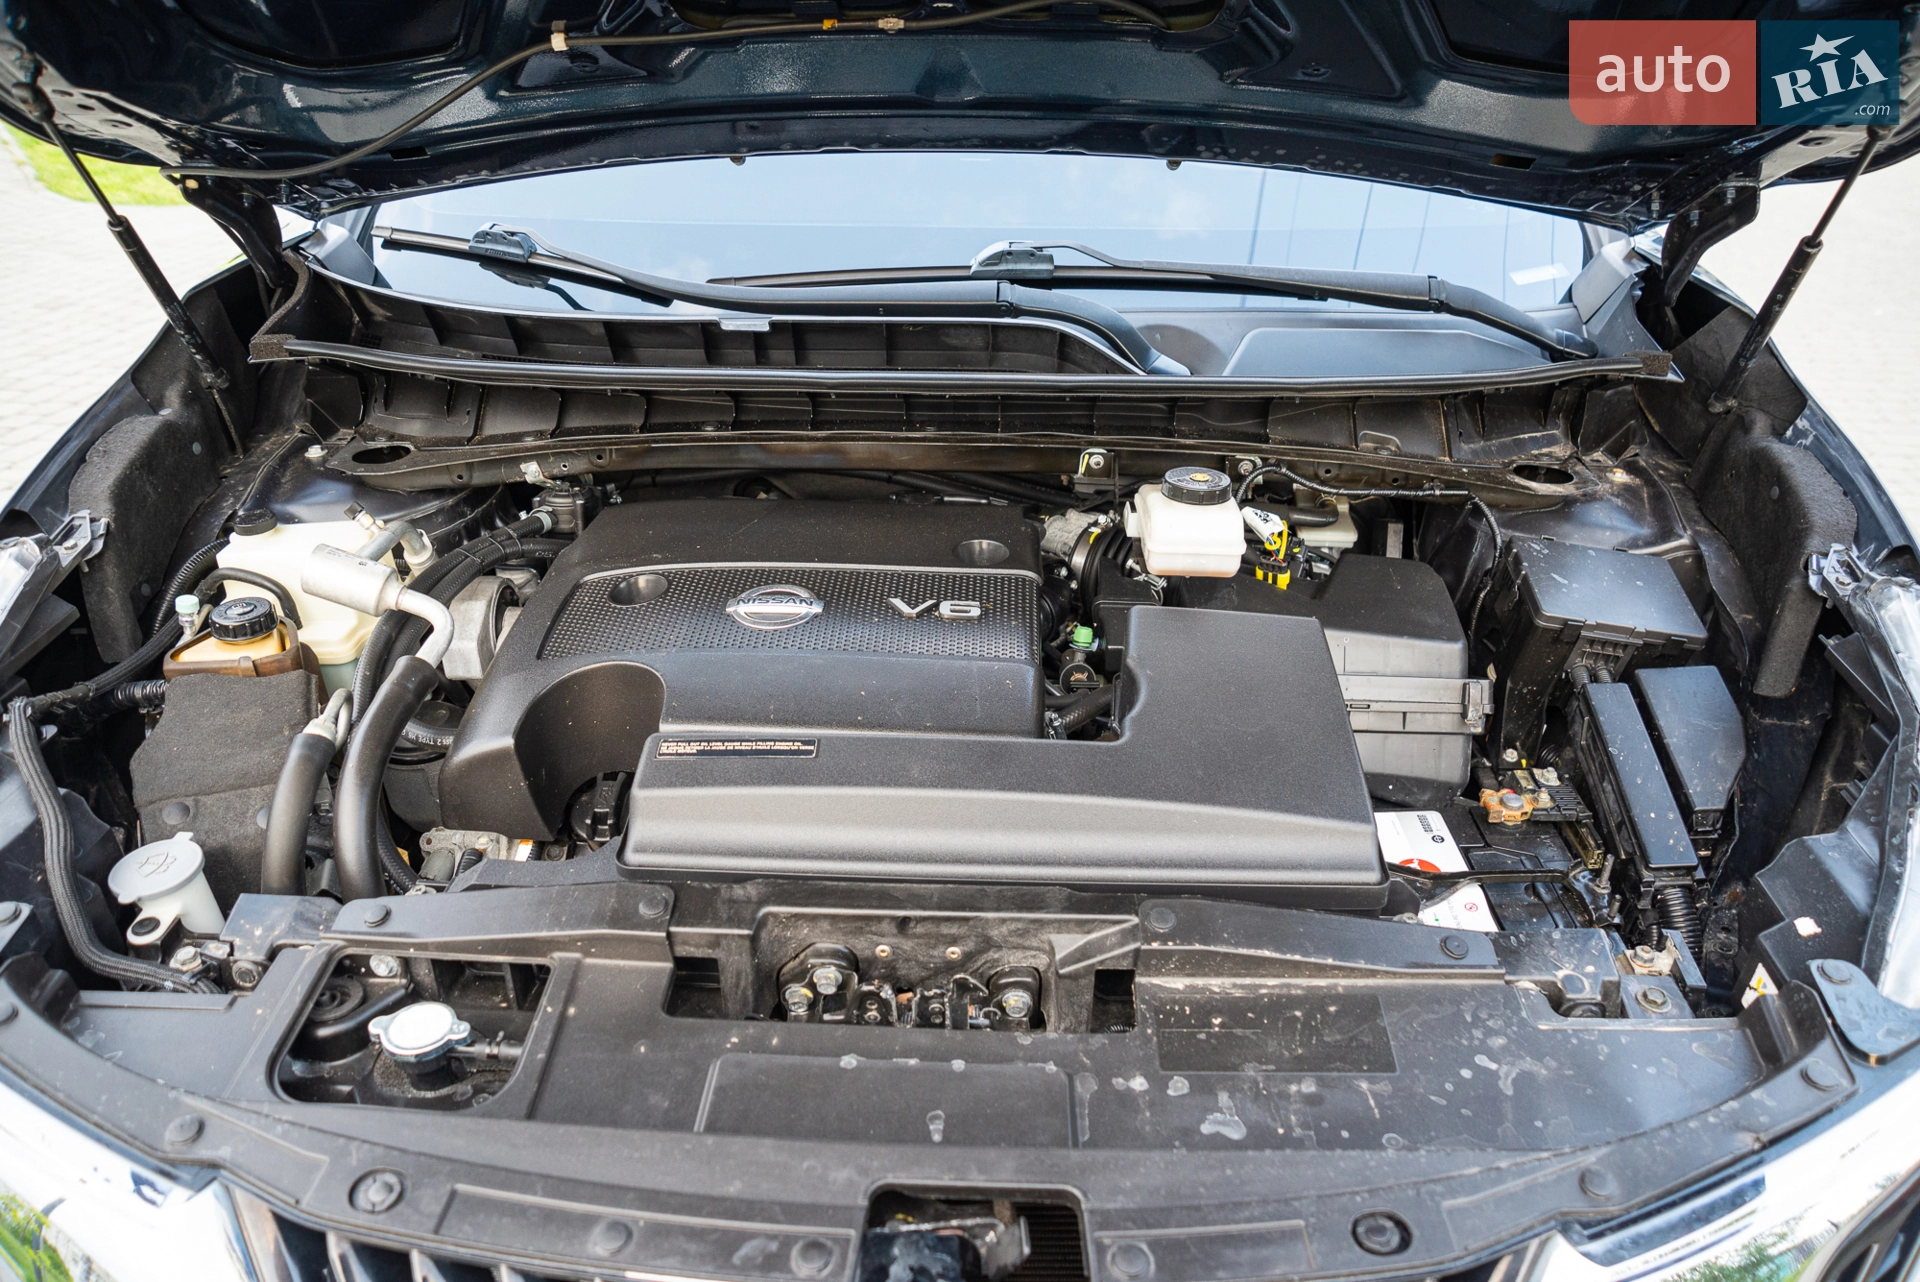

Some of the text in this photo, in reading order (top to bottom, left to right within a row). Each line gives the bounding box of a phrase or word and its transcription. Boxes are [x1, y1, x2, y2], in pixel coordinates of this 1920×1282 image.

[736, 596, 814, 607] NISSAN
[886, 597, 982, 621] V6
[418, 735, 434, 745] TYPE
